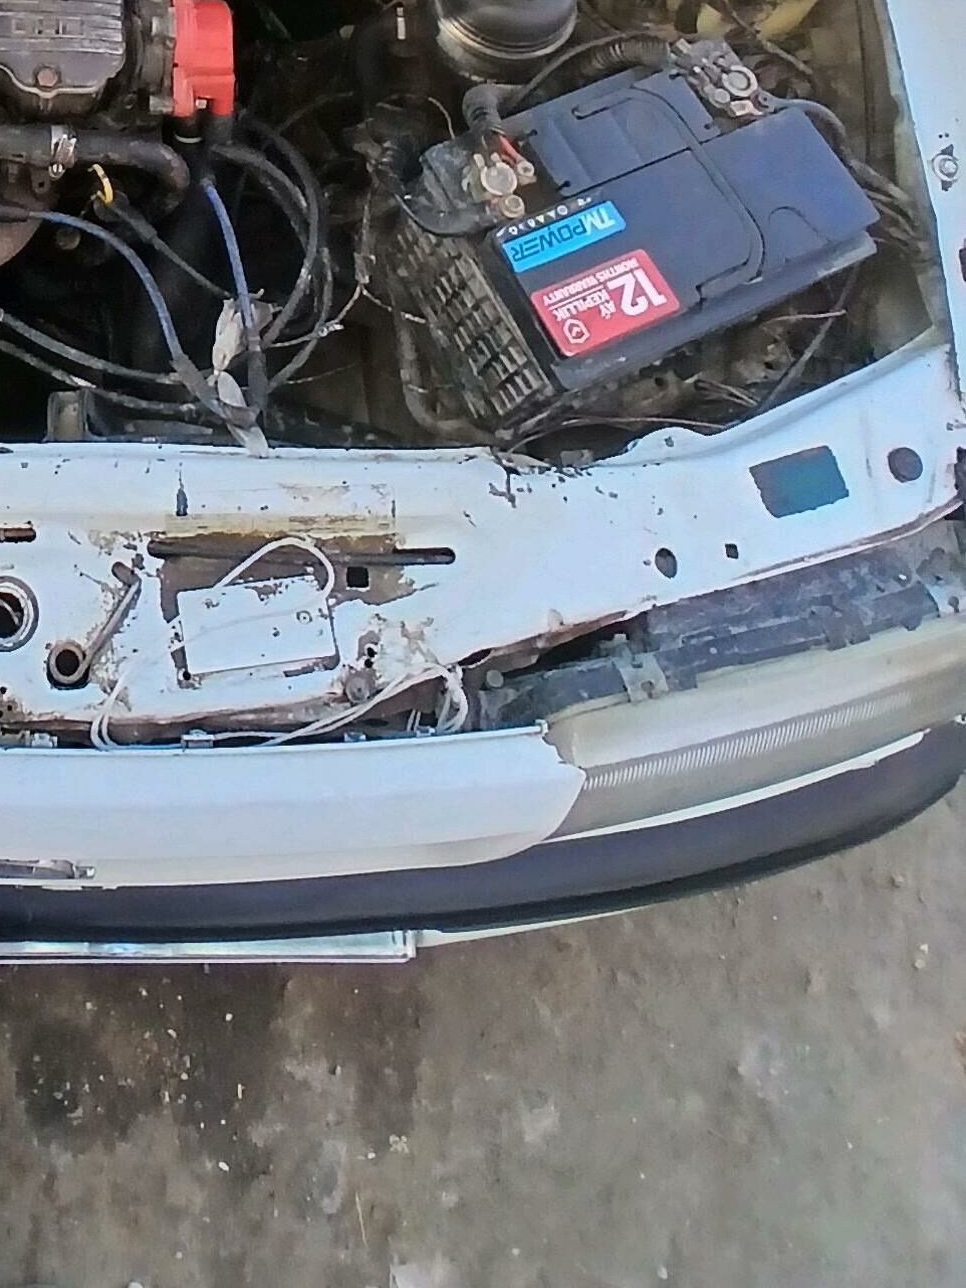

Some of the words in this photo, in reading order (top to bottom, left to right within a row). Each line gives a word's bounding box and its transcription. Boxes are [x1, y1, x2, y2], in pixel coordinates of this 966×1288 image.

[594, 257, 639, 285] MONTHS
[541, 274, 598, 306] WARRANTY
[606, 268, 667, 317] 12
